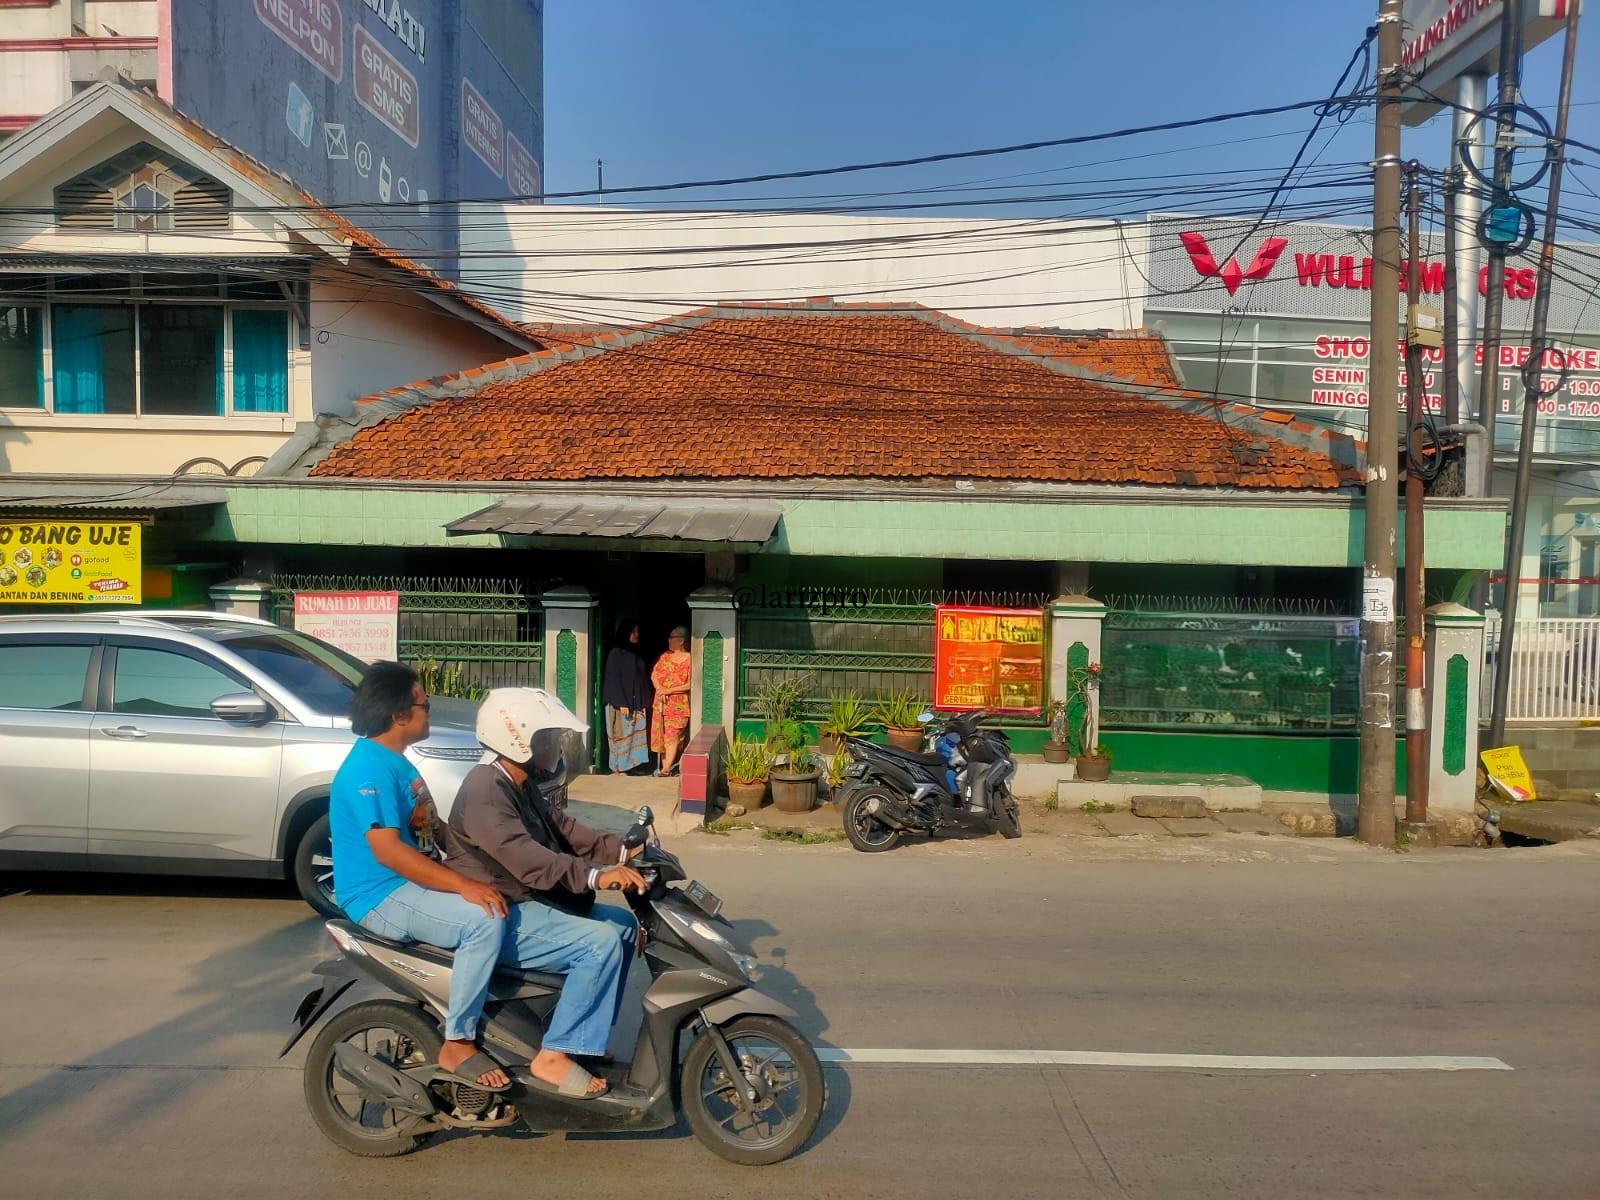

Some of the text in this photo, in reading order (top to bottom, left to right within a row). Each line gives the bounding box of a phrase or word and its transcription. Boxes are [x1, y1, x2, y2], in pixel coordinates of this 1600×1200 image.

[361, 43, 412, 105] GRATIS
[373, 80, 405, 126] SMS
[467, 95, 497, 140] GRATIS
[466, 119, 500, 167] INTERNET
[1314, 369, 1364, 384] SENIN
[20, 526, 82, 545] BANG
[89, 526, 132, 546] UJE
[30, 592, 48, 600] DAN
[51, 592, 84, 601] BENING
[300, 595, 394, 611] RUMAH DI JUAL
[699, 971, 728, 986] HONDA
